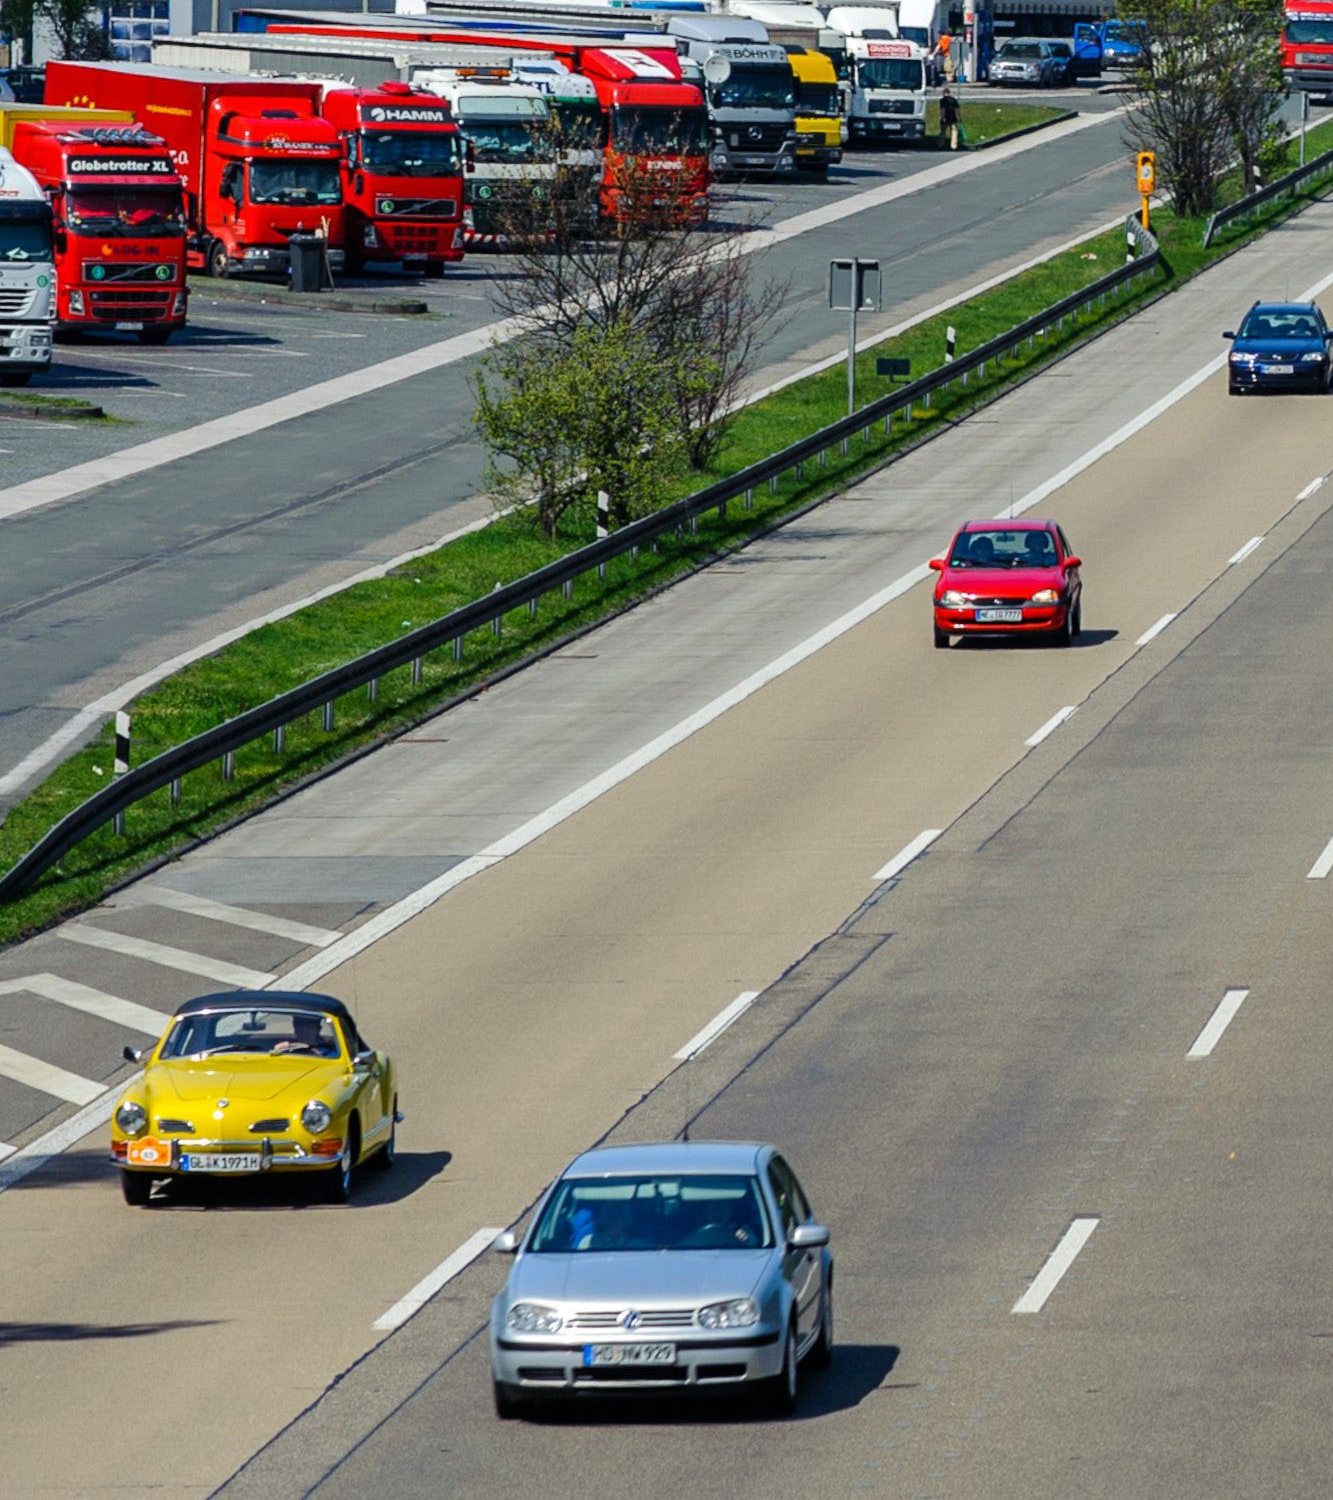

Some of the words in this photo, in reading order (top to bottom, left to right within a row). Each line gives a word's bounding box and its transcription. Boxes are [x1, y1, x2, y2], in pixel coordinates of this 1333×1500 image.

[385, 109, 444, 122] HAMM
[71, 160, 150, 172] Globetrotter
[152, 161, 169, 172] XL
